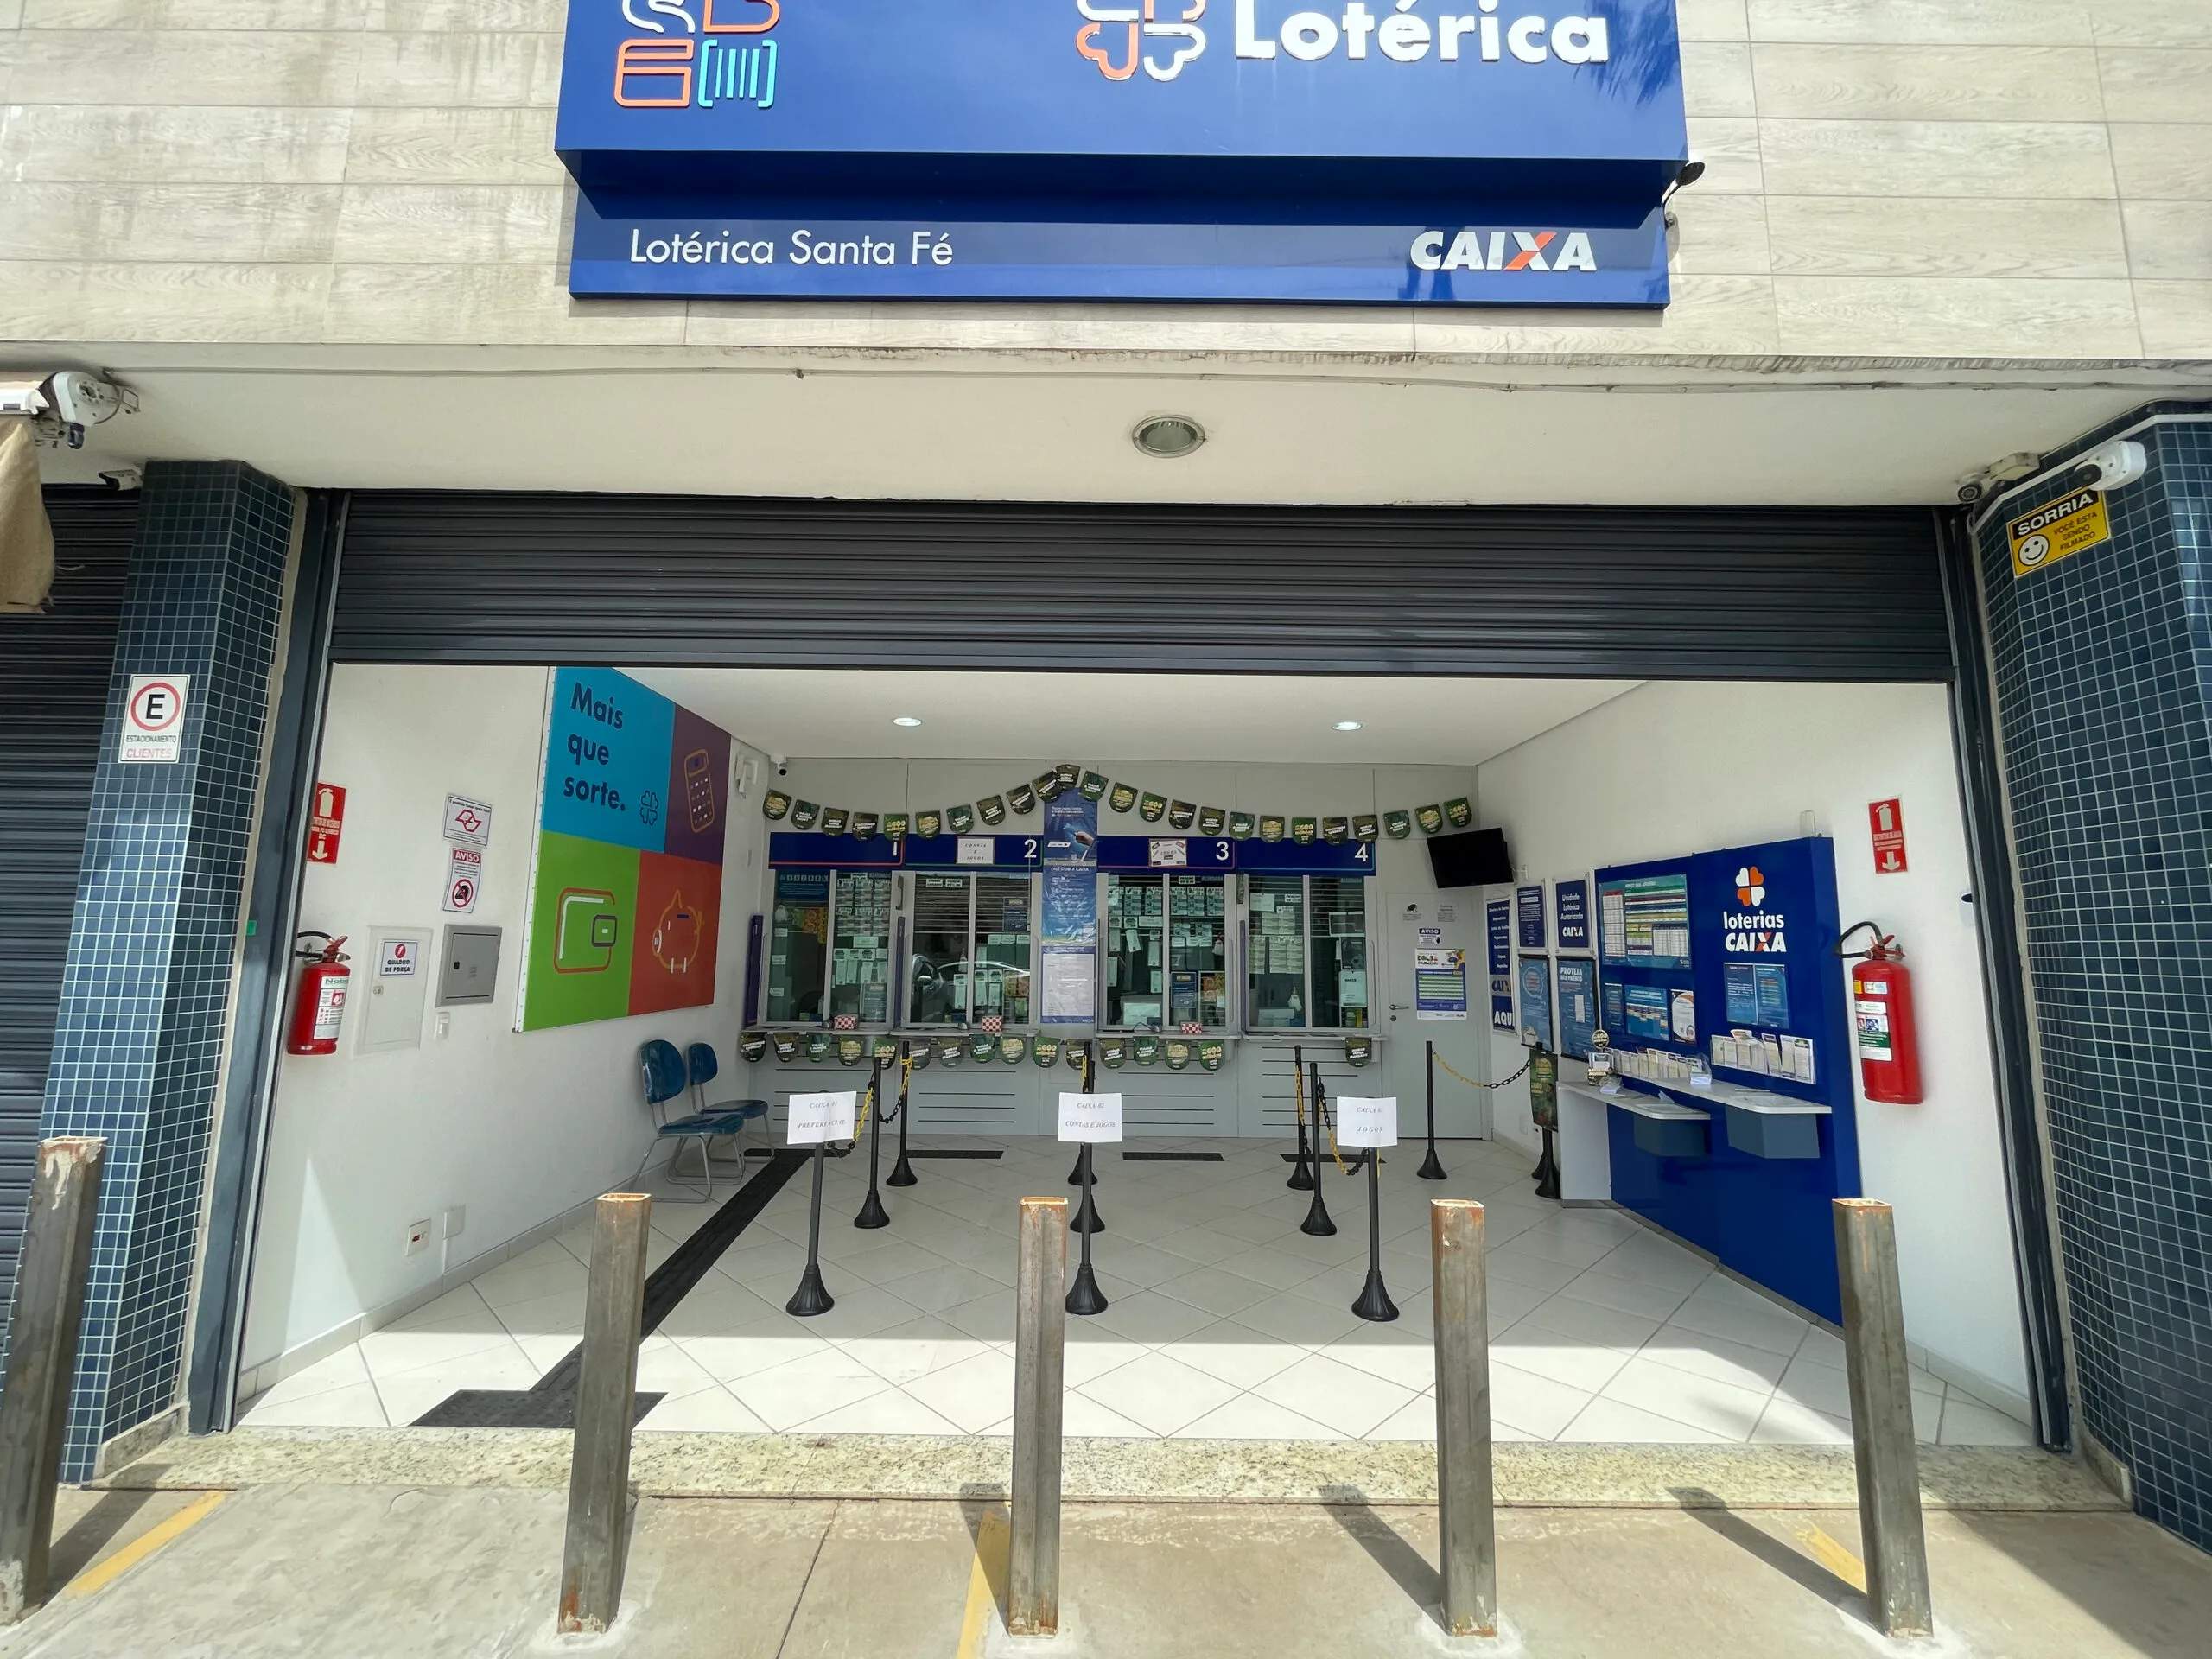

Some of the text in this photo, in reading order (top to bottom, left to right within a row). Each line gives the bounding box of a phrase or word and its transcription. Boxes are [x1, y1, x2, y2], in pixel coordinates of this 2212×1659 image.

[1235, 0, 1609, 64] Lotérica
[632, 229, 954, 266] Lotérica Santa Fé
[1410, 230, 1598, 272] CAIXA
[2018, 493, 2094, 537] SORRIA
[2060, 531, 2096, 551] FILMADO
[2063, 524, 2090, 541] SENDO
[146, 694, 166, 720] E
[570, 681, 624, 730] Mais
[125, 734, 177, 743] ESTACIONAMENTO
[567, 731, 610, 766] que
[126, 747, 173, 759] CLIENTES
[563, 775, 626, 812] sorte.
[455, 851, 480, 862] AVISO
[1024, 839, 1037, 858] 2
[1216, 841, 1229, 861] 3
[1354, 842, 1369, 862] 4
[1723, 910, 1785, 930] loterias
[1562, 926, 1584, 937] CAIXA
[1725, 931, 1787, 952] CAIXA
